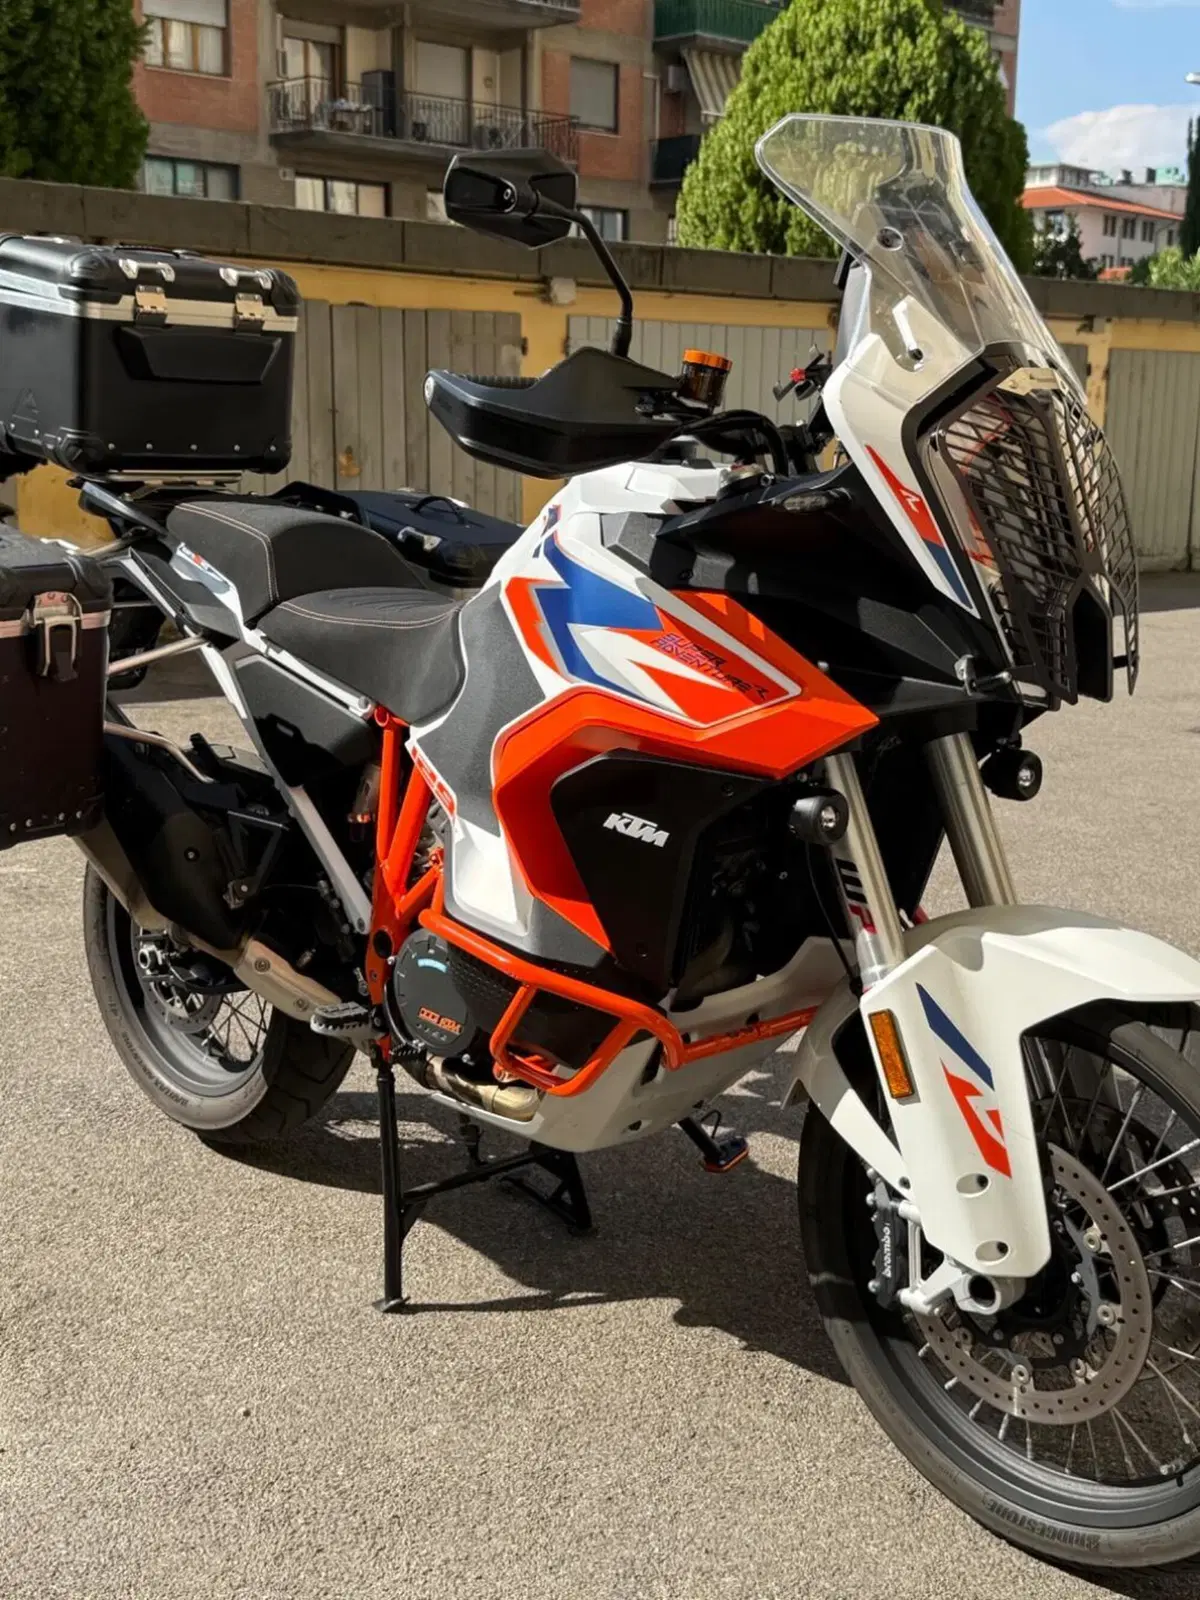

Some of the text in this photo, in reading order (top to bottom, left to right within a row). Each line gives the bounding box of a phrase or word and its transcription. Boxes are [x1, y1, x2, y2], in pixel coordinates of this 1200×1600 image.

[650, 638, 752, 693] ADVENTURE
[664, 632, 727, 666] SUPER
[603, 812, 670, 848] KTM
[881, 1225, 892, 1278] brembo
